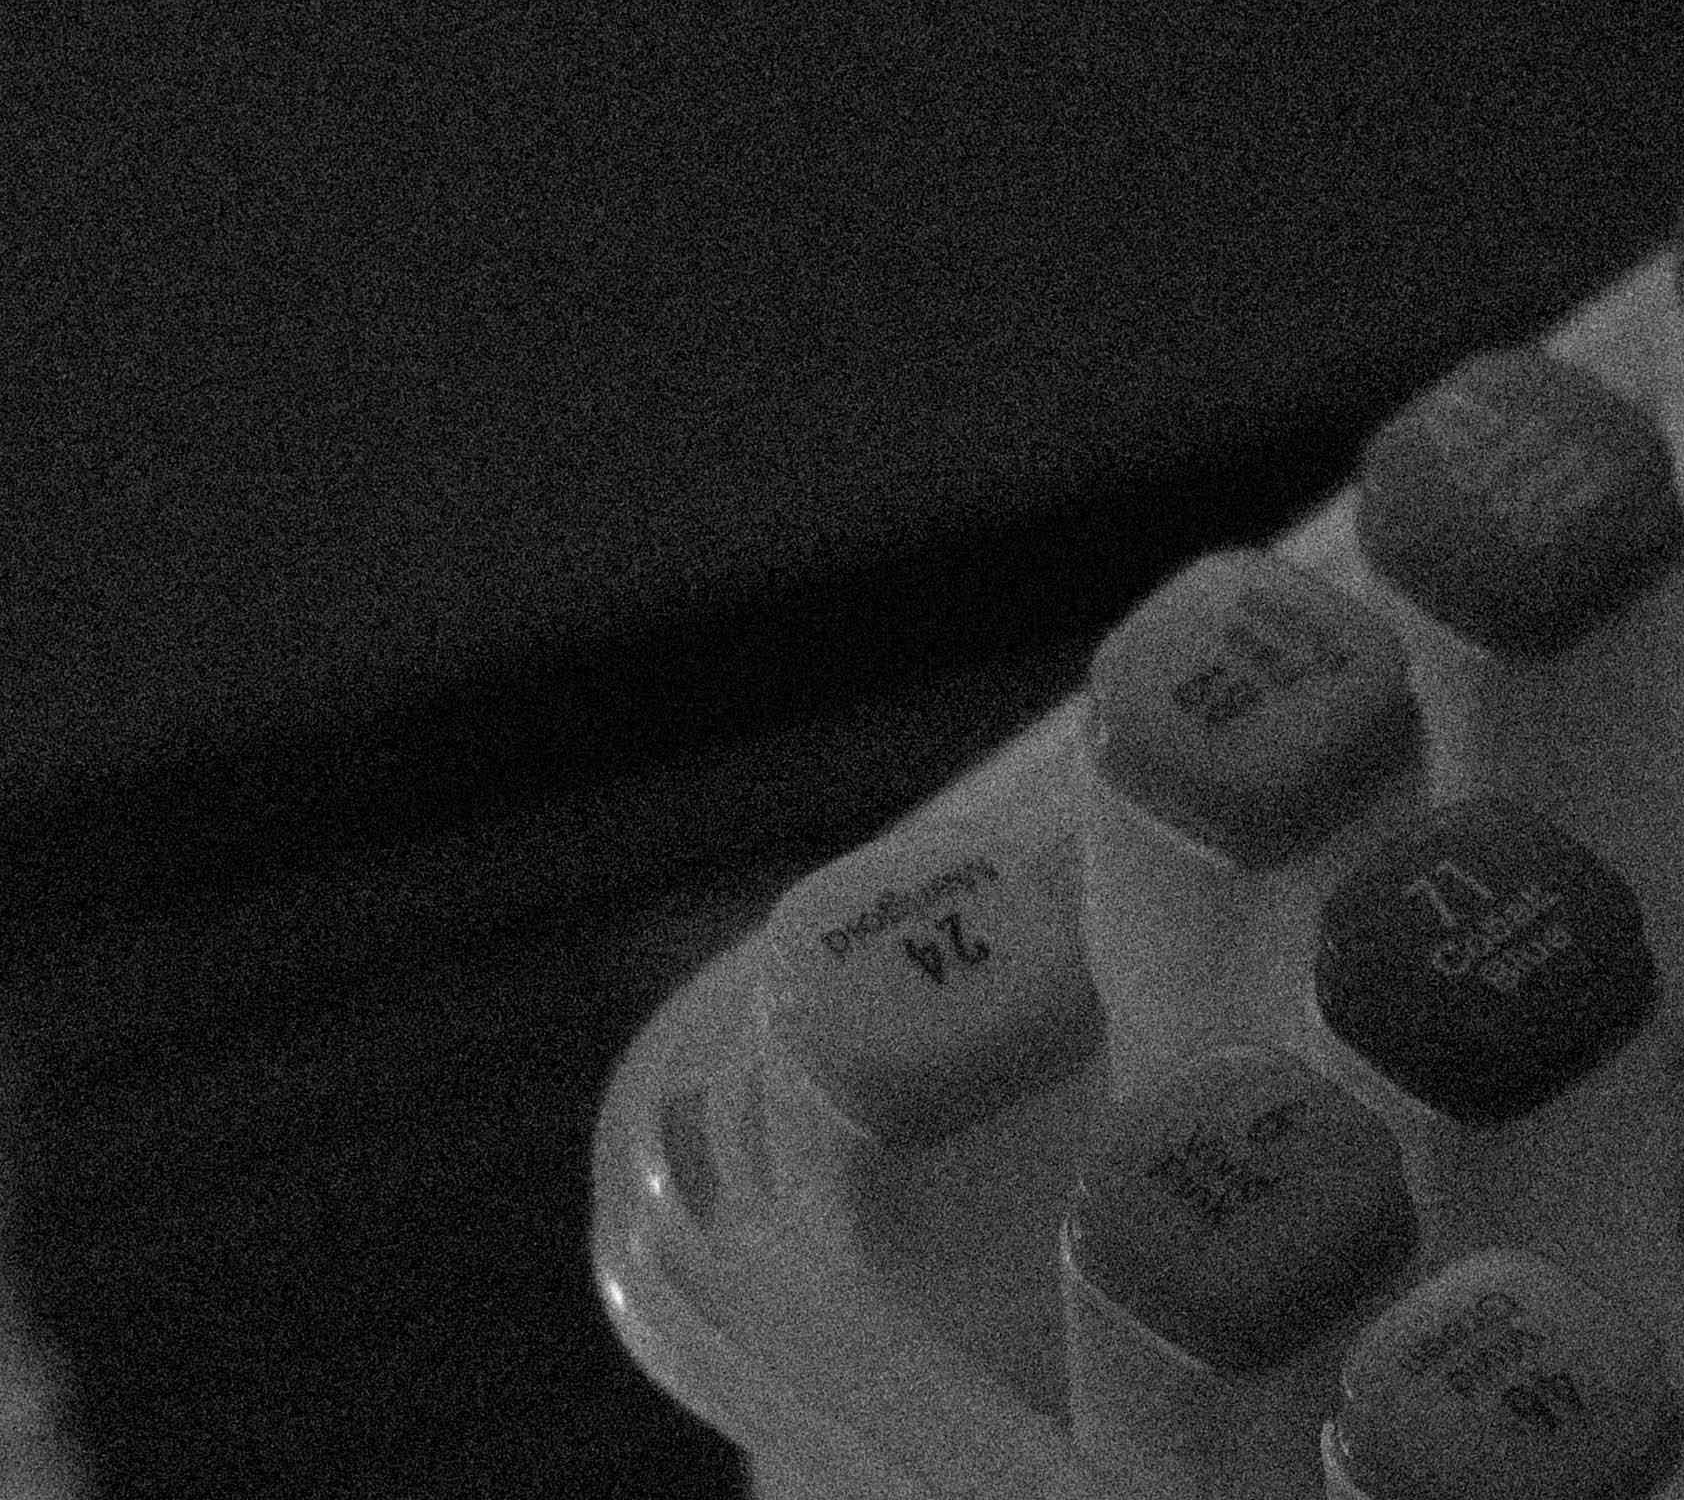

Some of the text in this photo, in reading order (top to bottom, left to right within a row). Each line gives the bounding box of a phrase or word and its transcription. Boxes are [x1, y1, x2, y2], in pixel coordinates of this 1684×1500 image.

[1400, 858, 1495, 927] 71
[902, 914, 991, 985] 24
[1476, 923, 1575, 995] Blue
